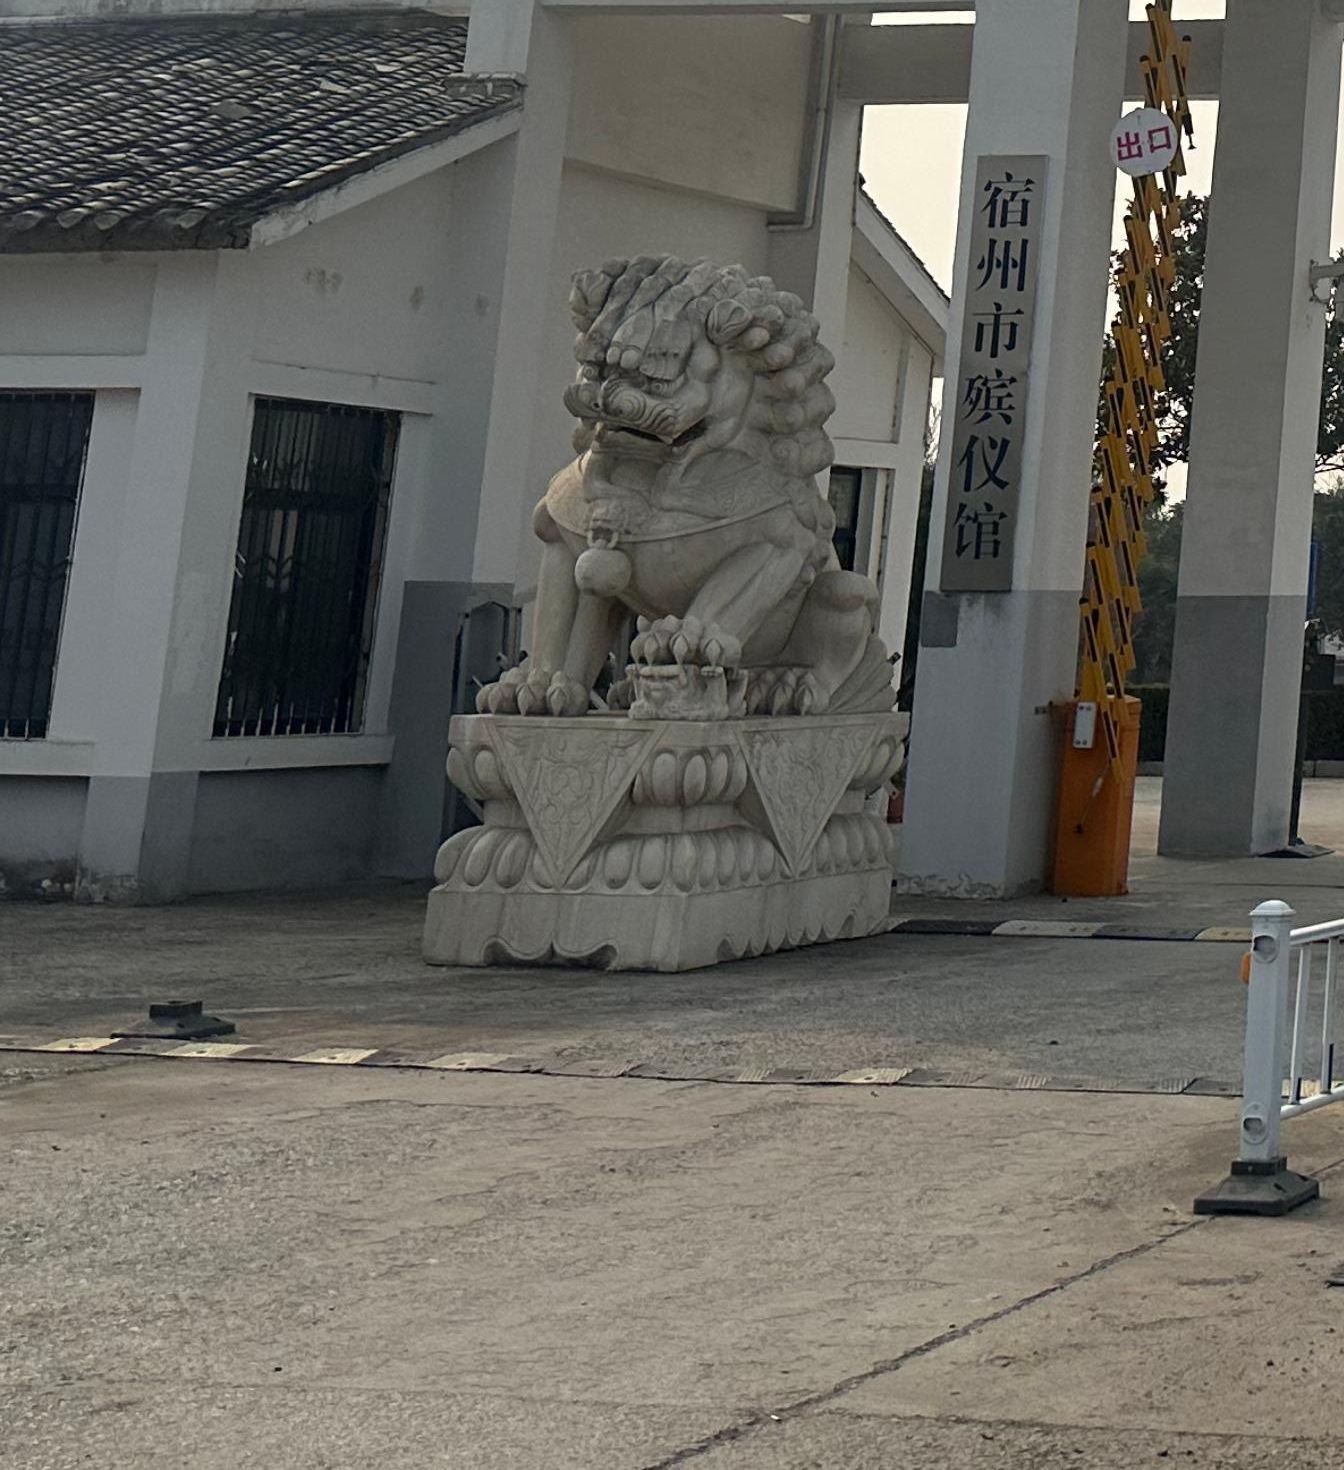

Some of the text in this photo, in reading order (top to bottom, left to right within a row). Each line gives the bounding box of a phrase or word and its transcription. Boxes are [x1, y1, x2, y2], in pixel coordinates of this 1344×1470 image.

[1117, 126, 1171, 161] 出口
[953, 171, 1036, 560] 宿州市殡仪馆
